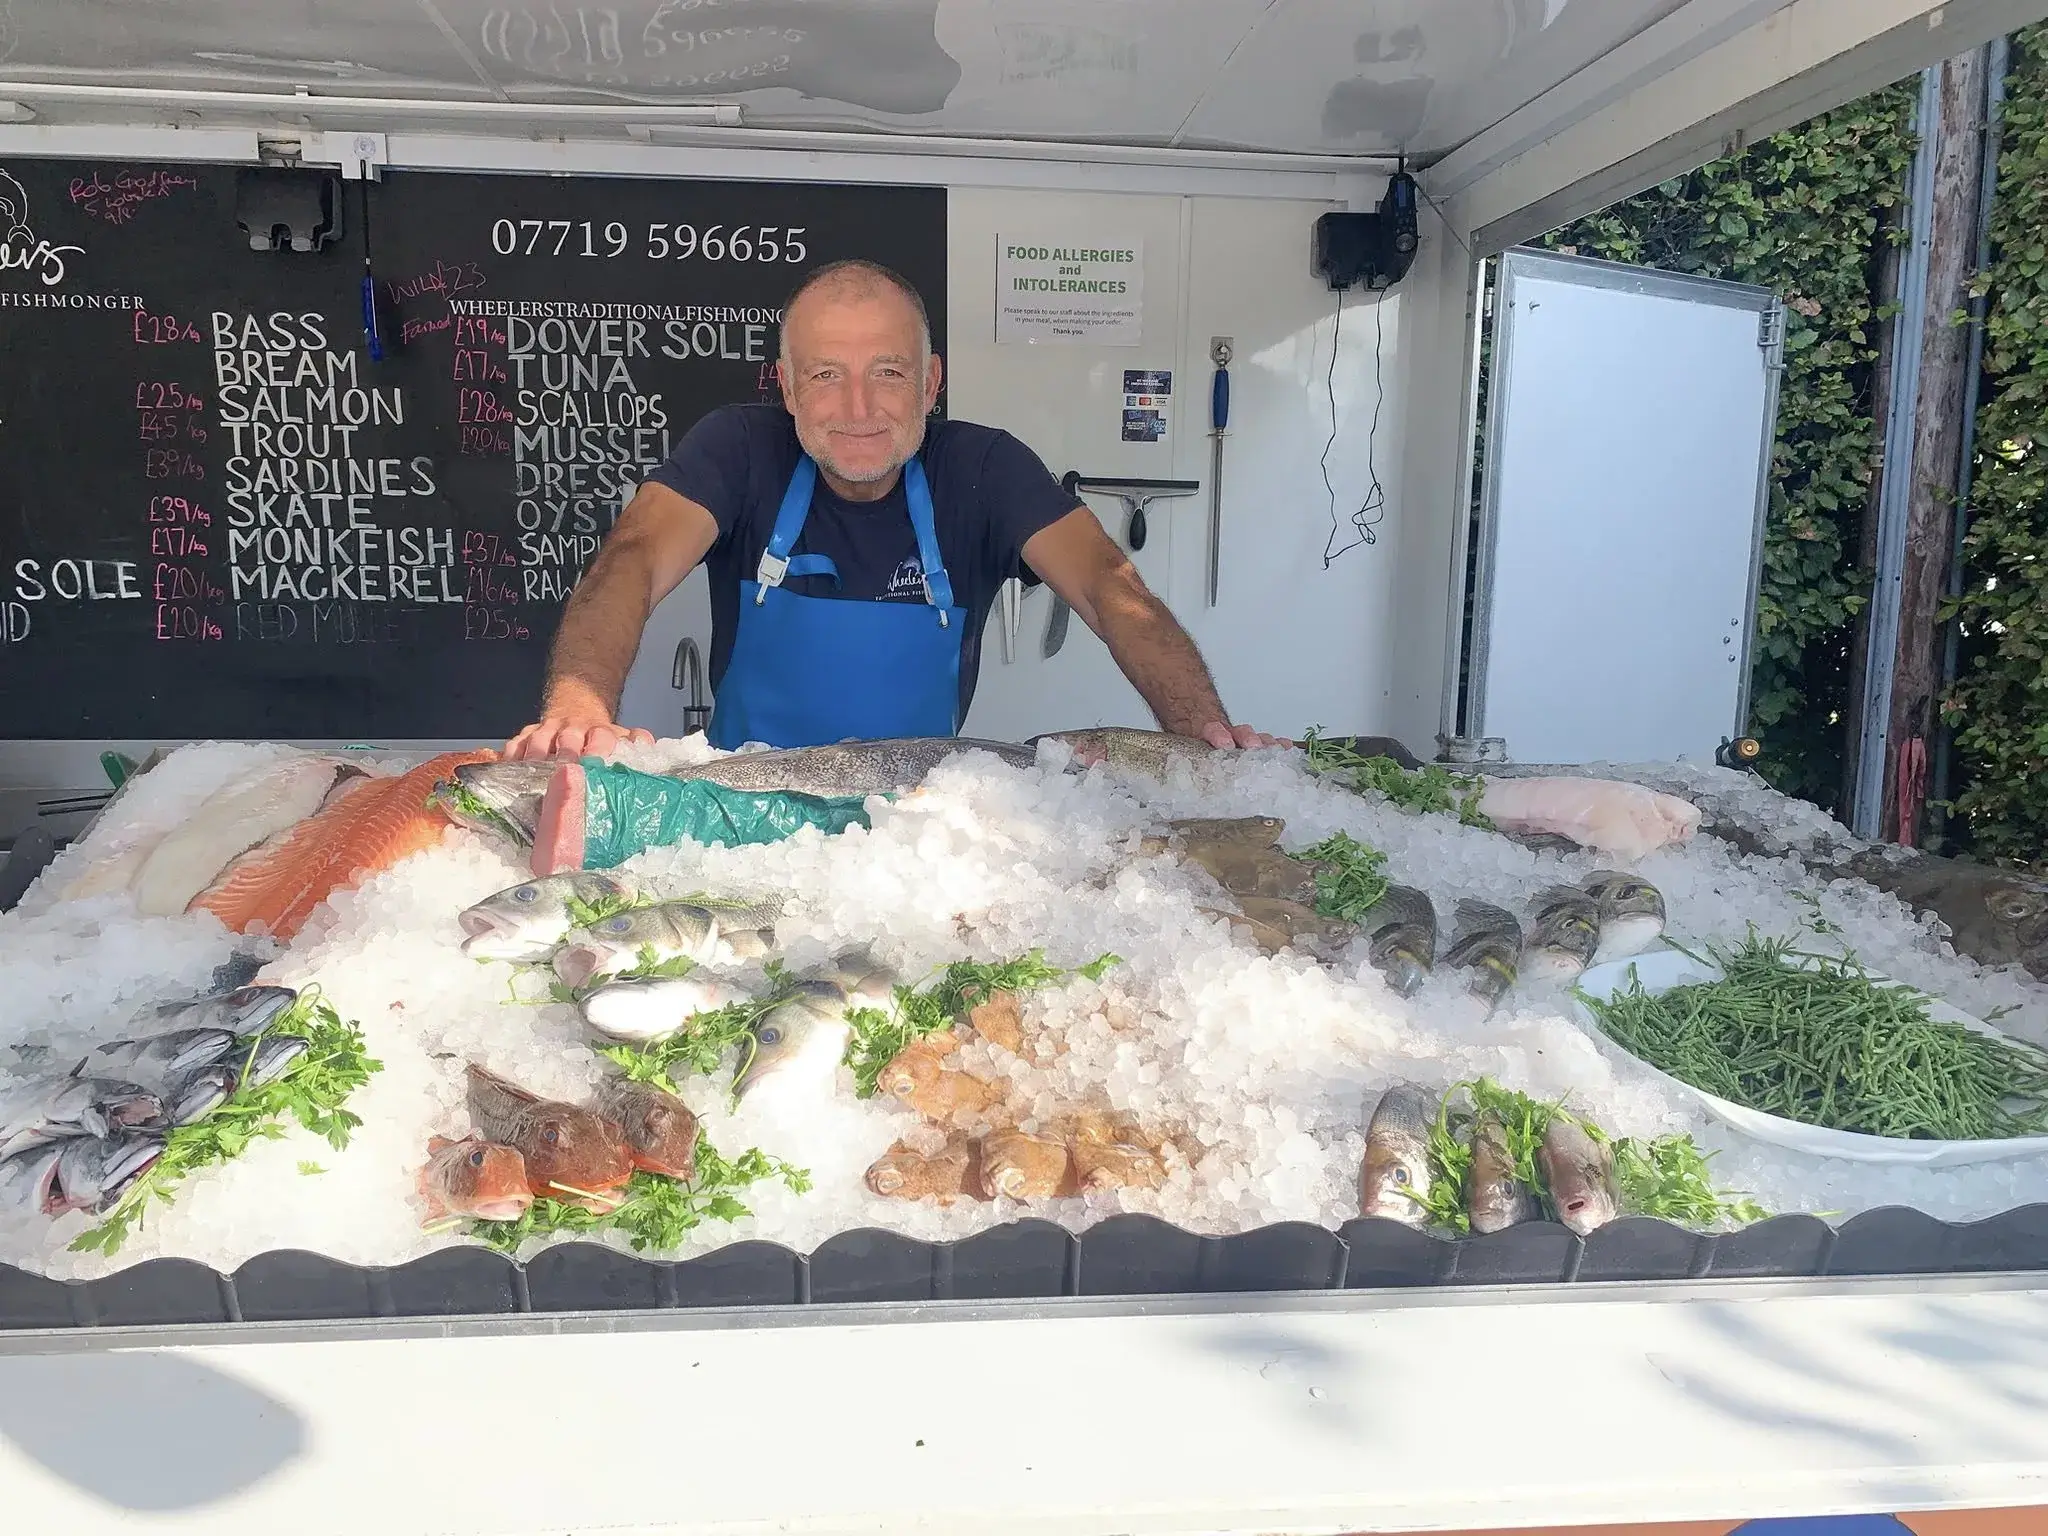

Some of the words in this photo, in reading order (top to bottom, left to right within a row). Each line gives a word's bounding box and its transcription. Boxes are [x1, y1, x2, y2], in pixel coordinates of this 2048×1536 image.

[491, 218, 629, 259] 07719
[647, 223, 808, 264] 596655
[1007, 246, 1049, 261] FOOD
[1052, 248, 1134, 263] ALLERGIES
[1013, 278, 1127, 294] INTOLERANCES
[1059, 265, 1081, 276] and
[1, 293, 146, 310] FISHMONGER
[1024, 308, 1041, 316] speak
[212, 311, 327, 350] BASS
[507, 316, 652, 359] DOVER
[661, 321, 767, 362] SOLE
[214, 350, 358, 388] BREAM
[507, 353, 638, 394] TUNA
[218, 385, 404, 425] SALMON
[516, 389, 668, 429] SCALLOPS
[220, 421, 359, 458] TROUT
[225, 456, 437, 497] SARDINES
[227, 492, 378, 530] SKATE
[229, 526, 456, 567] MONKFISH
[15, 558, 142, 601] SOLE
[231, 564, 464, 603] MACKEREL
